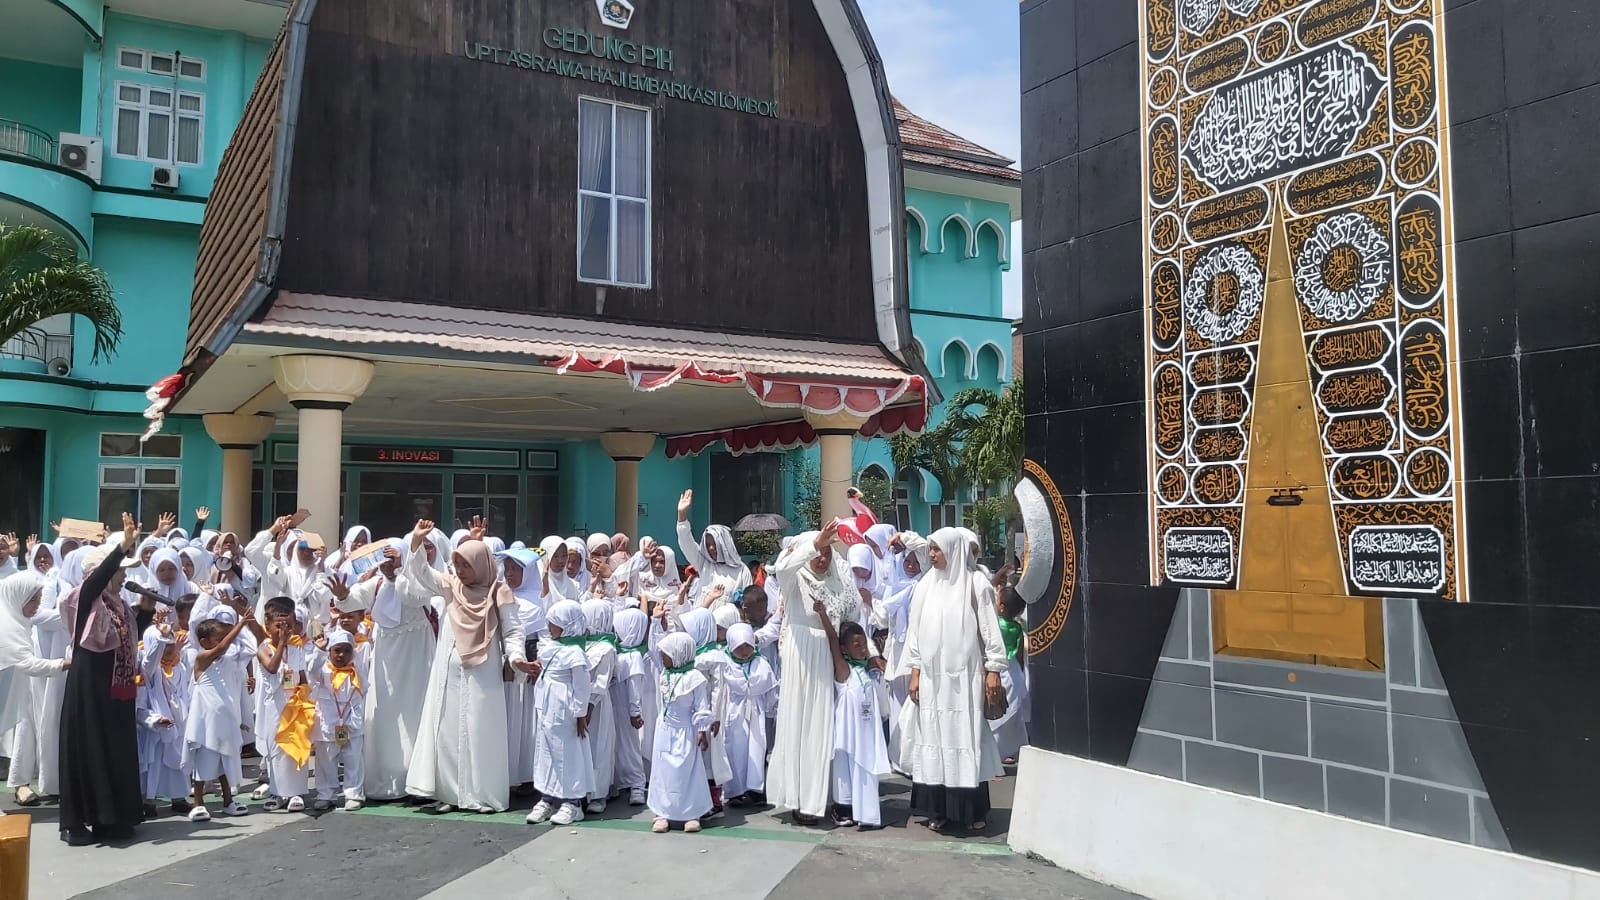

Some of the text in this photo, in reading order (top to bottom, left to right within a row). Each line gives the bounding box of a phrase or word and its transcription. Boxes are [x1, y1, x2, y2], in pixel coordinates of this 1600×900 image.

[543, 27, 673, 71] GEDUNG PIH
[464, 40, 778, 118] UPT ASRAMA HAJI EMBARKASI LOMBOK
[377, 449, 440, 461] 3. INOVASI
